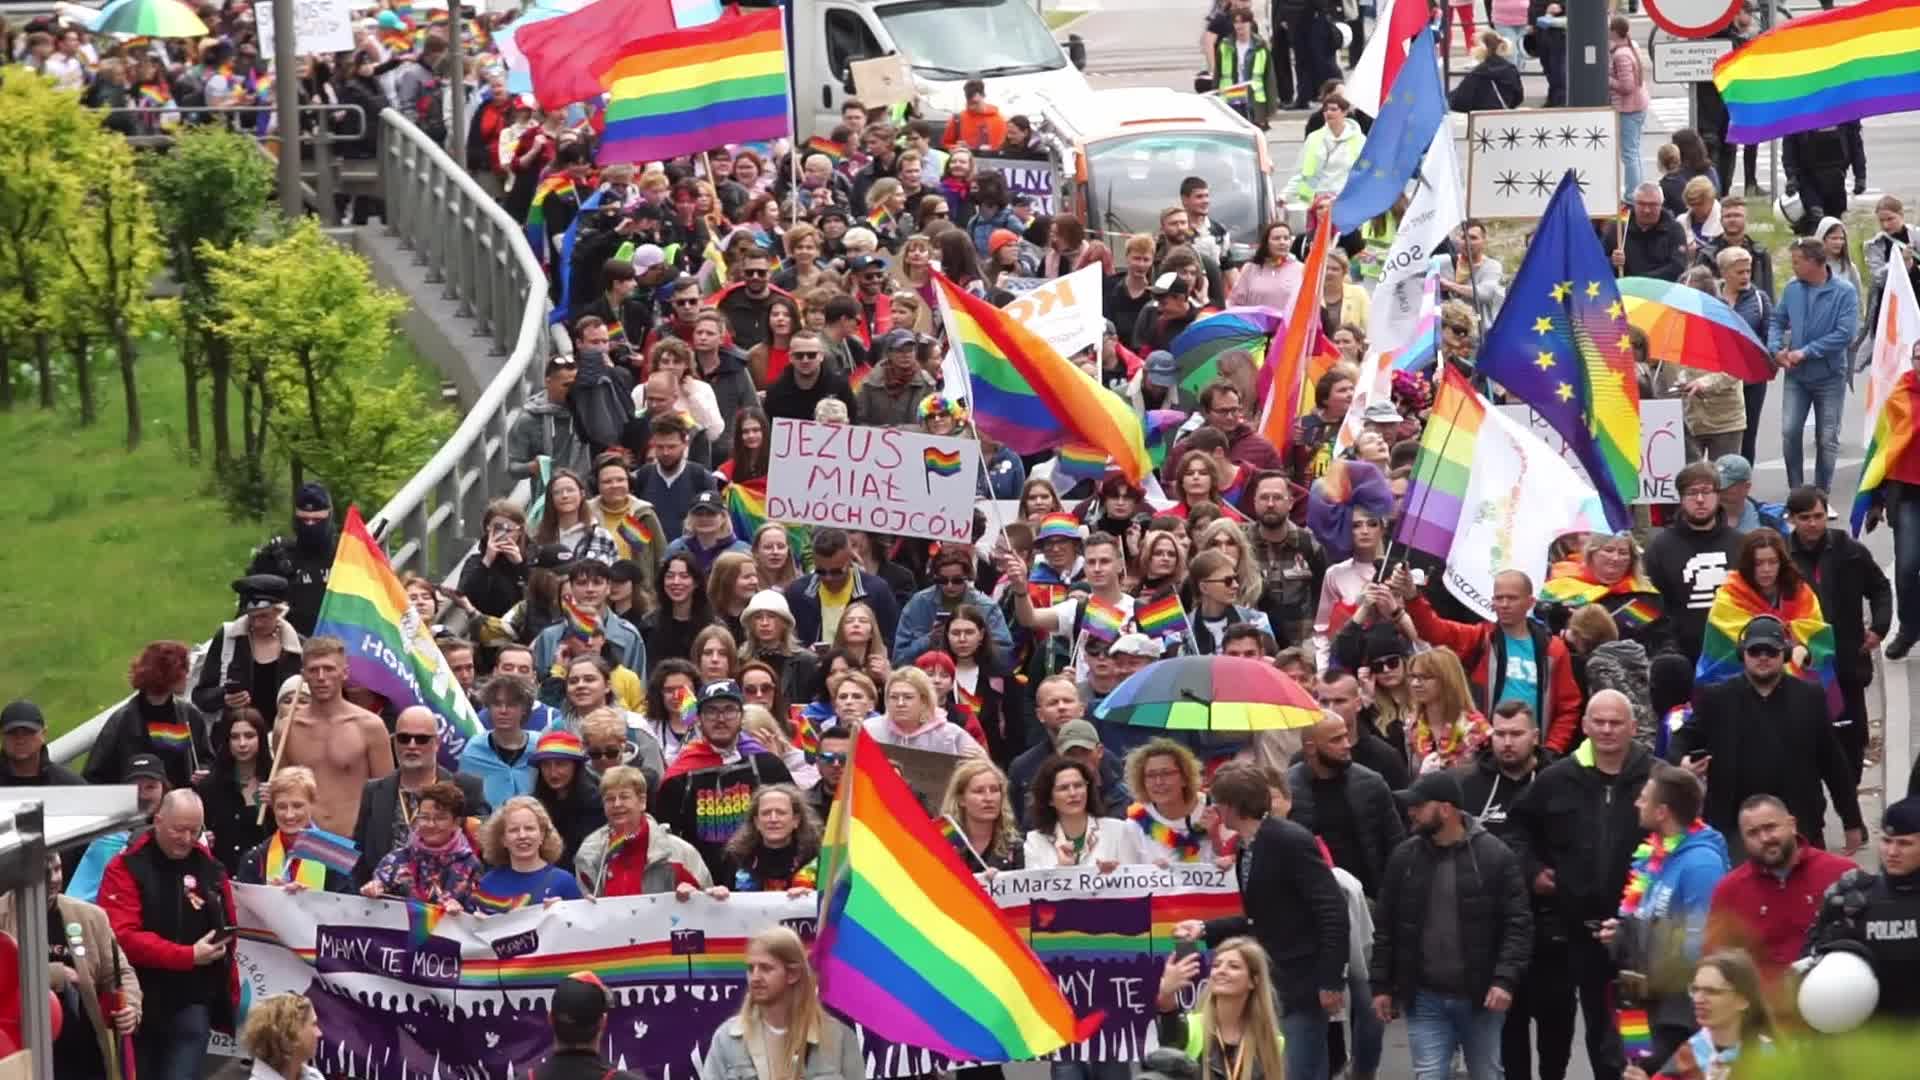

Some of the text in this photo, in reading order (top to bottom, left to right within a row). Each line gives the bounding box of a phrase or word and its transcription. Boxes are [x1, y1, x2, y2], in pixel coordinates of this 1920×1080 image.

[775, 420, 903, 469] JEZUS
[807, 464, 910, 503] MIAŁ
[767, 492, 971, 539] DWÓCH OJCÓW
[1012, 877, 1072, 894] Marsz
[1079, 871, 1175, 890] Równości
[1181, 870, 1226, 887] 2022
[320, 933, 373, 962] MAMY
[1866, 919, 1919, 940] POLICJA
[1058, 968, 1096, 1008] MY
[1109, 977, 1148, 1014] TĘ
